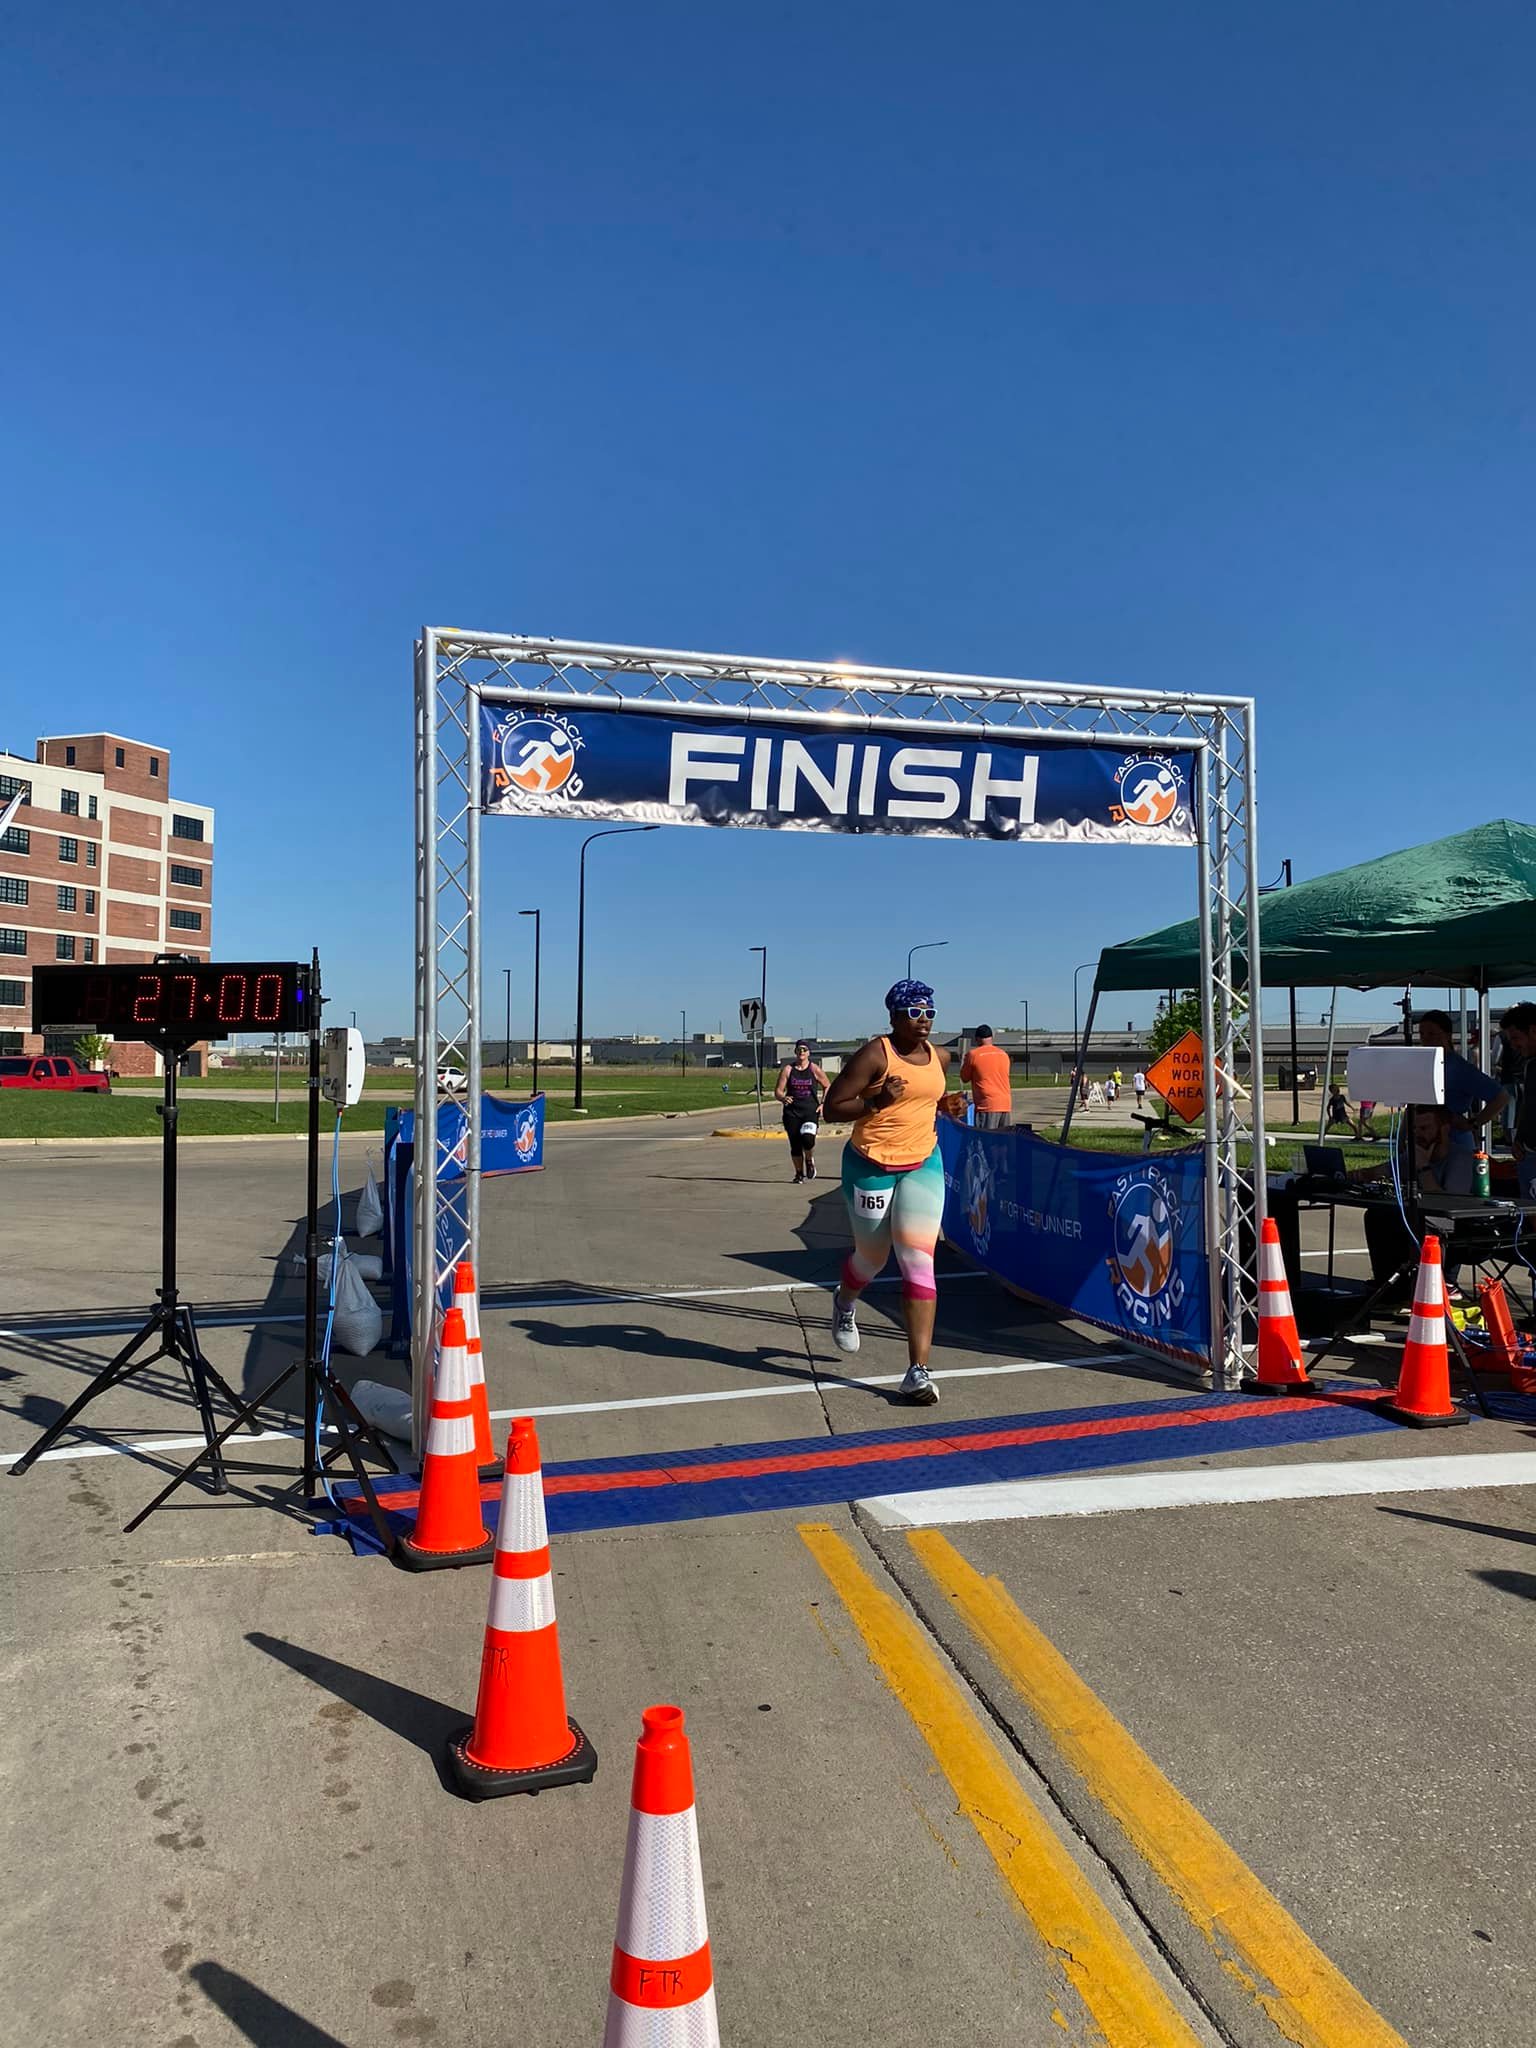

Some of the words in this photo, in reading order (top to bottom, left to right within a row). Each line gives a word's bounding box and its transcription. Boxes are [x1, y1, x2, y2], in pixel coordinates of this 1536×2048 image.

[492, 707, 527, 743] FAST
[534, 706, 586, 751] TRACK
[668, 731, 1039, 825] FINISH
[1113, 752, 1141, 784] FAST
[1173, 1052, 1203, 1064] ROA
[1172, 1069, 1204, 1081] WOR
[1167, 1086, 1204, 1098] AHEA
[860, 1194, 885, 1210] 765
[640, 1968, 684, 1997] FTR
